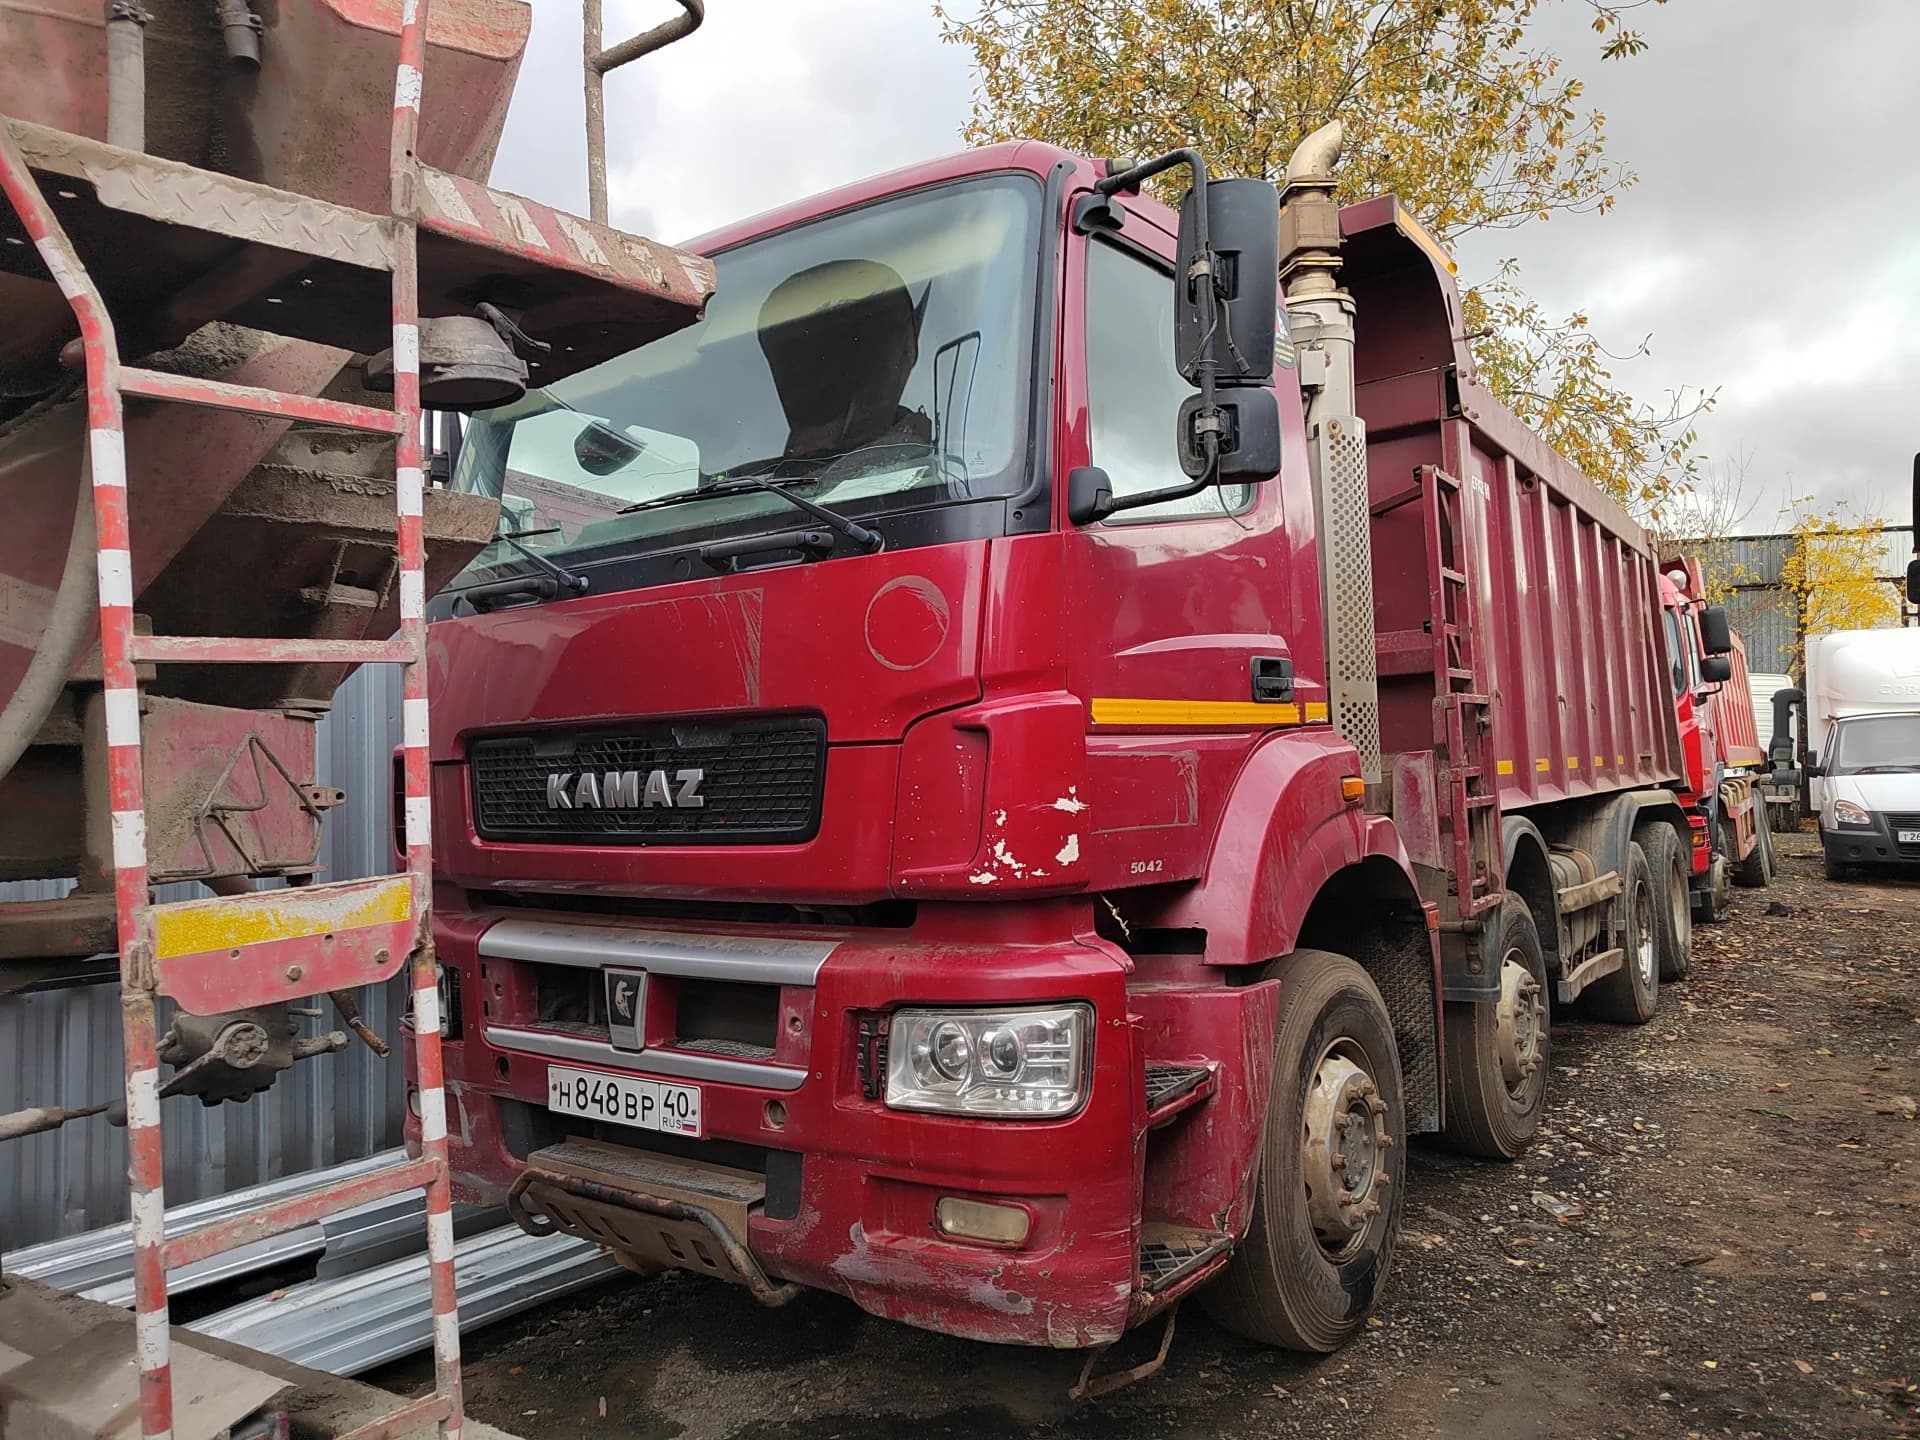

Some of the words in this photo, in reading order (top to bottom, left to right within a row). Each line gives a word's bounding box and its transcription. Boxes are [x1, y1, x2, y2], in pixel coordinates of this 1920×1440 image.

[546, 768, 704, 809] KAMAZ
[1130, 859, 1163, 874] 5042
[663, 1089, 689, 1118] 40
[662, 1116, 682, 1130] RUS
